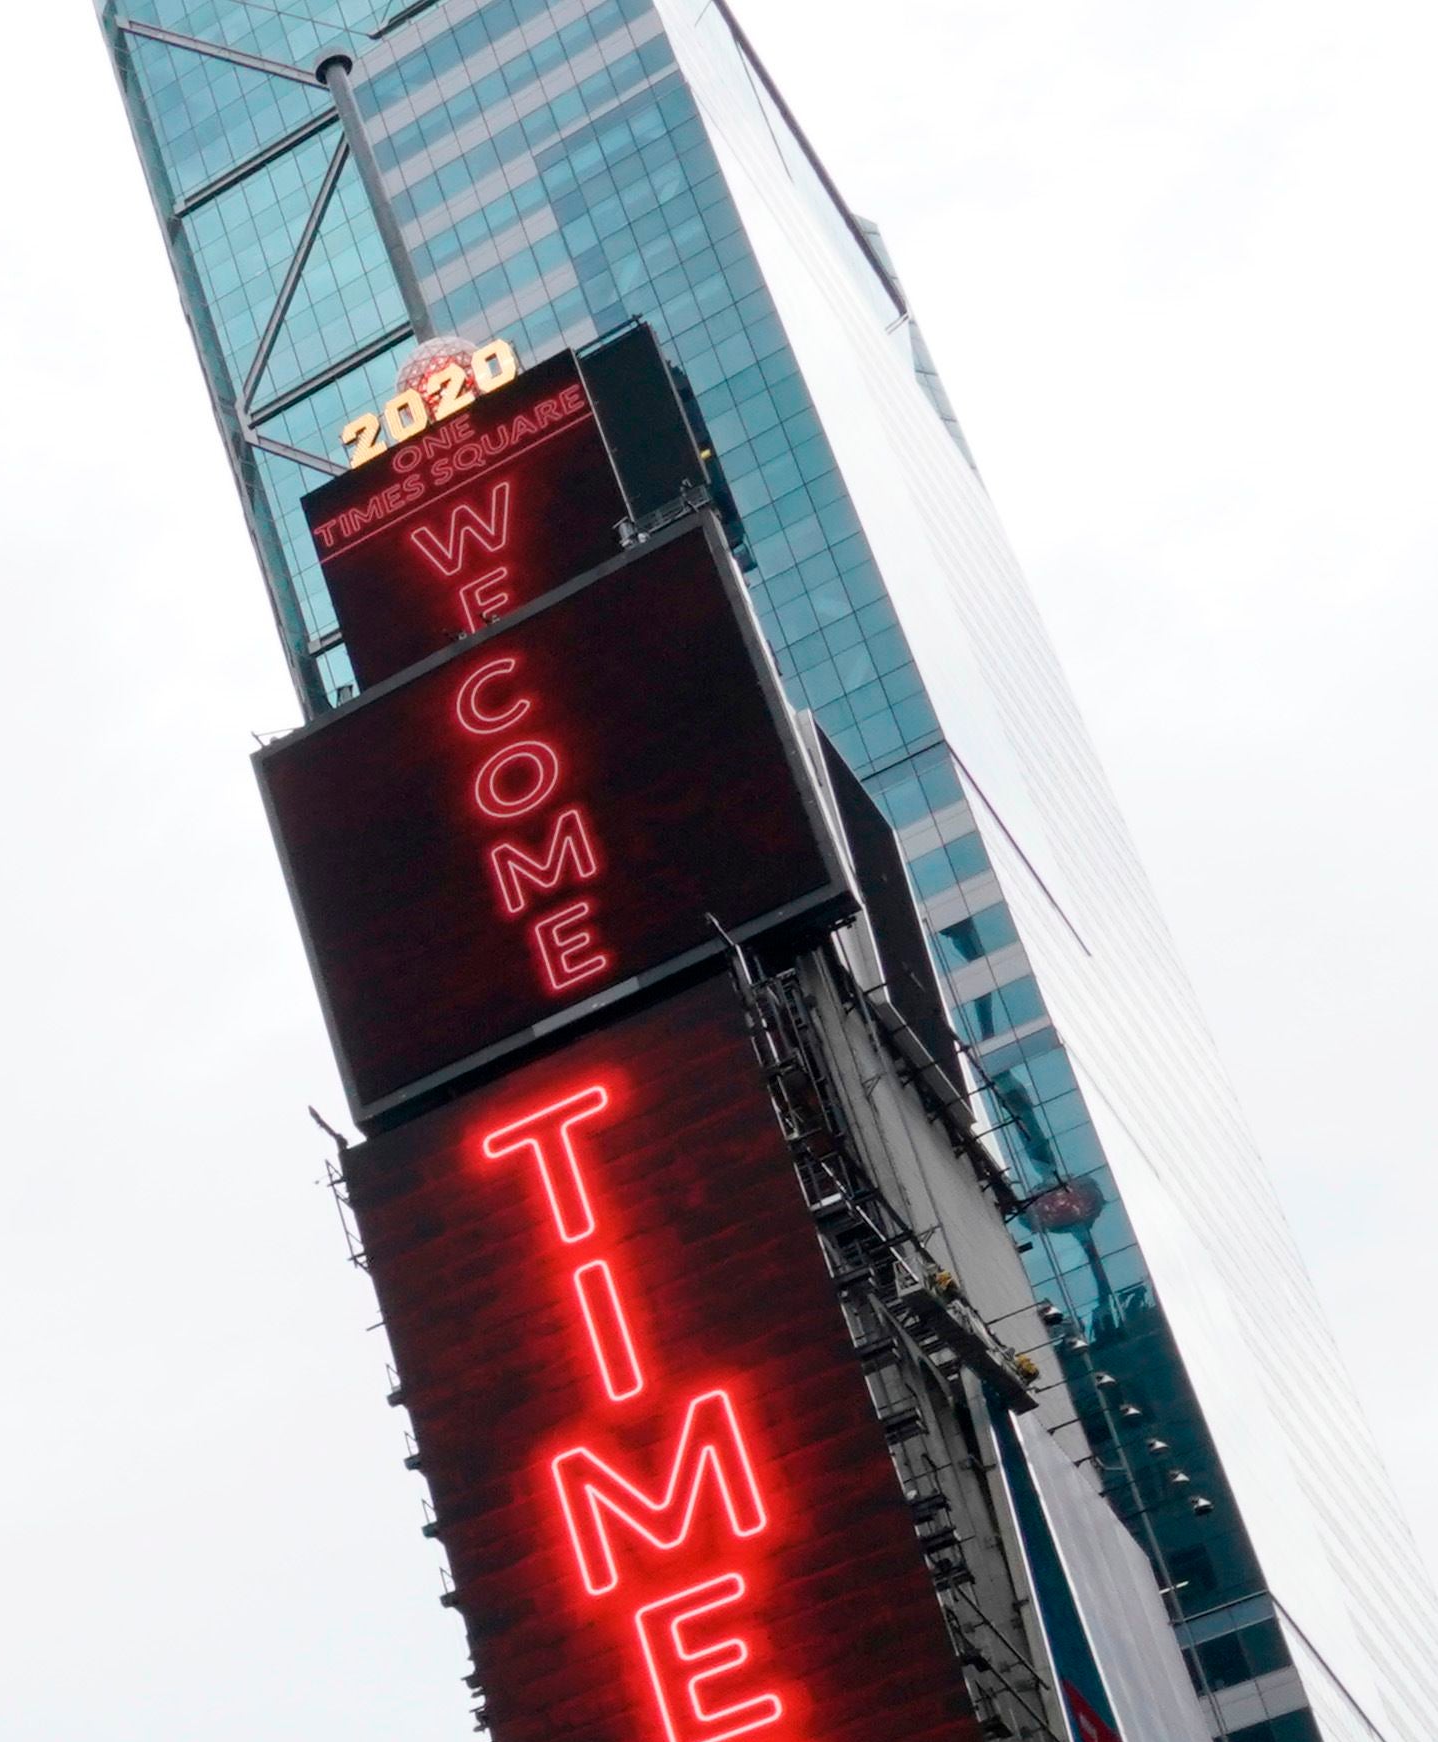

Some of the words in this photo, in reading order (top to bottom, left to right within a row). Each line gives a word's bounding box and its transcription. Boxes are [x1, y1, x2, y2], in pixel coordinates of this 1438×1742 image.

[313, 473, 425, 549] TIMES
[430, 383, 586, 486] SQUARE
[342, 338, 519, 470] 2020
[392, 413, 476, 474] ONE
[411, 481, 608, 991] WECOME
